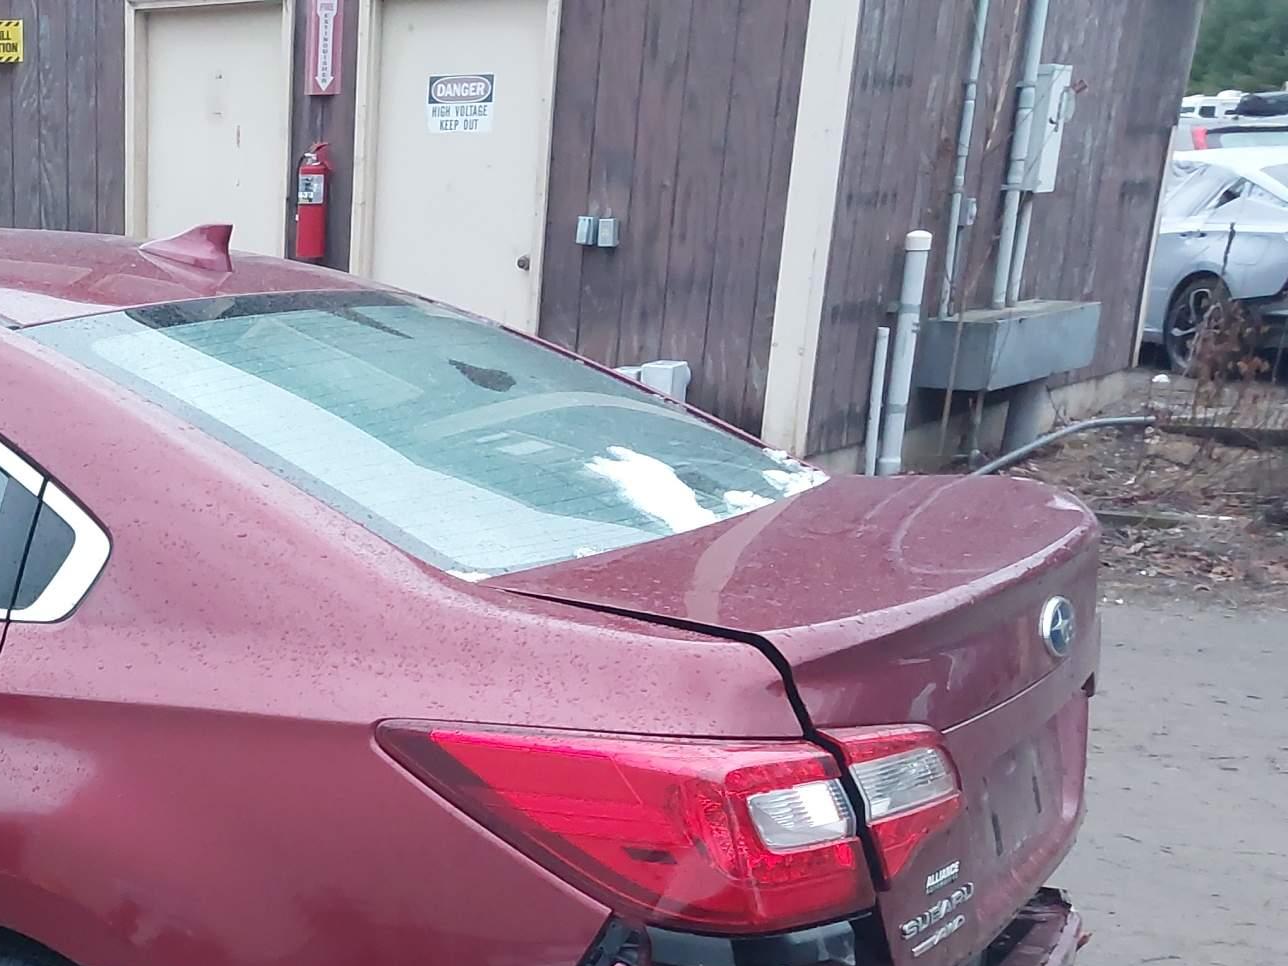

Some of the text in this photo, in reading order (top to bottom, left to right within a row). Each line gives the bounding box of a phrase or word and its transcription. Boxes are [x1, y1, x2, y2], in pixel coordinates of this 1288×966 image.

[436, 82, 486, 97] DANGER
[431, 104, 488, 118] HIGH VOLTAGE
[439, 119, 479, 131] KEEP OUT
[899, 882, 974, 940] SUBARU
